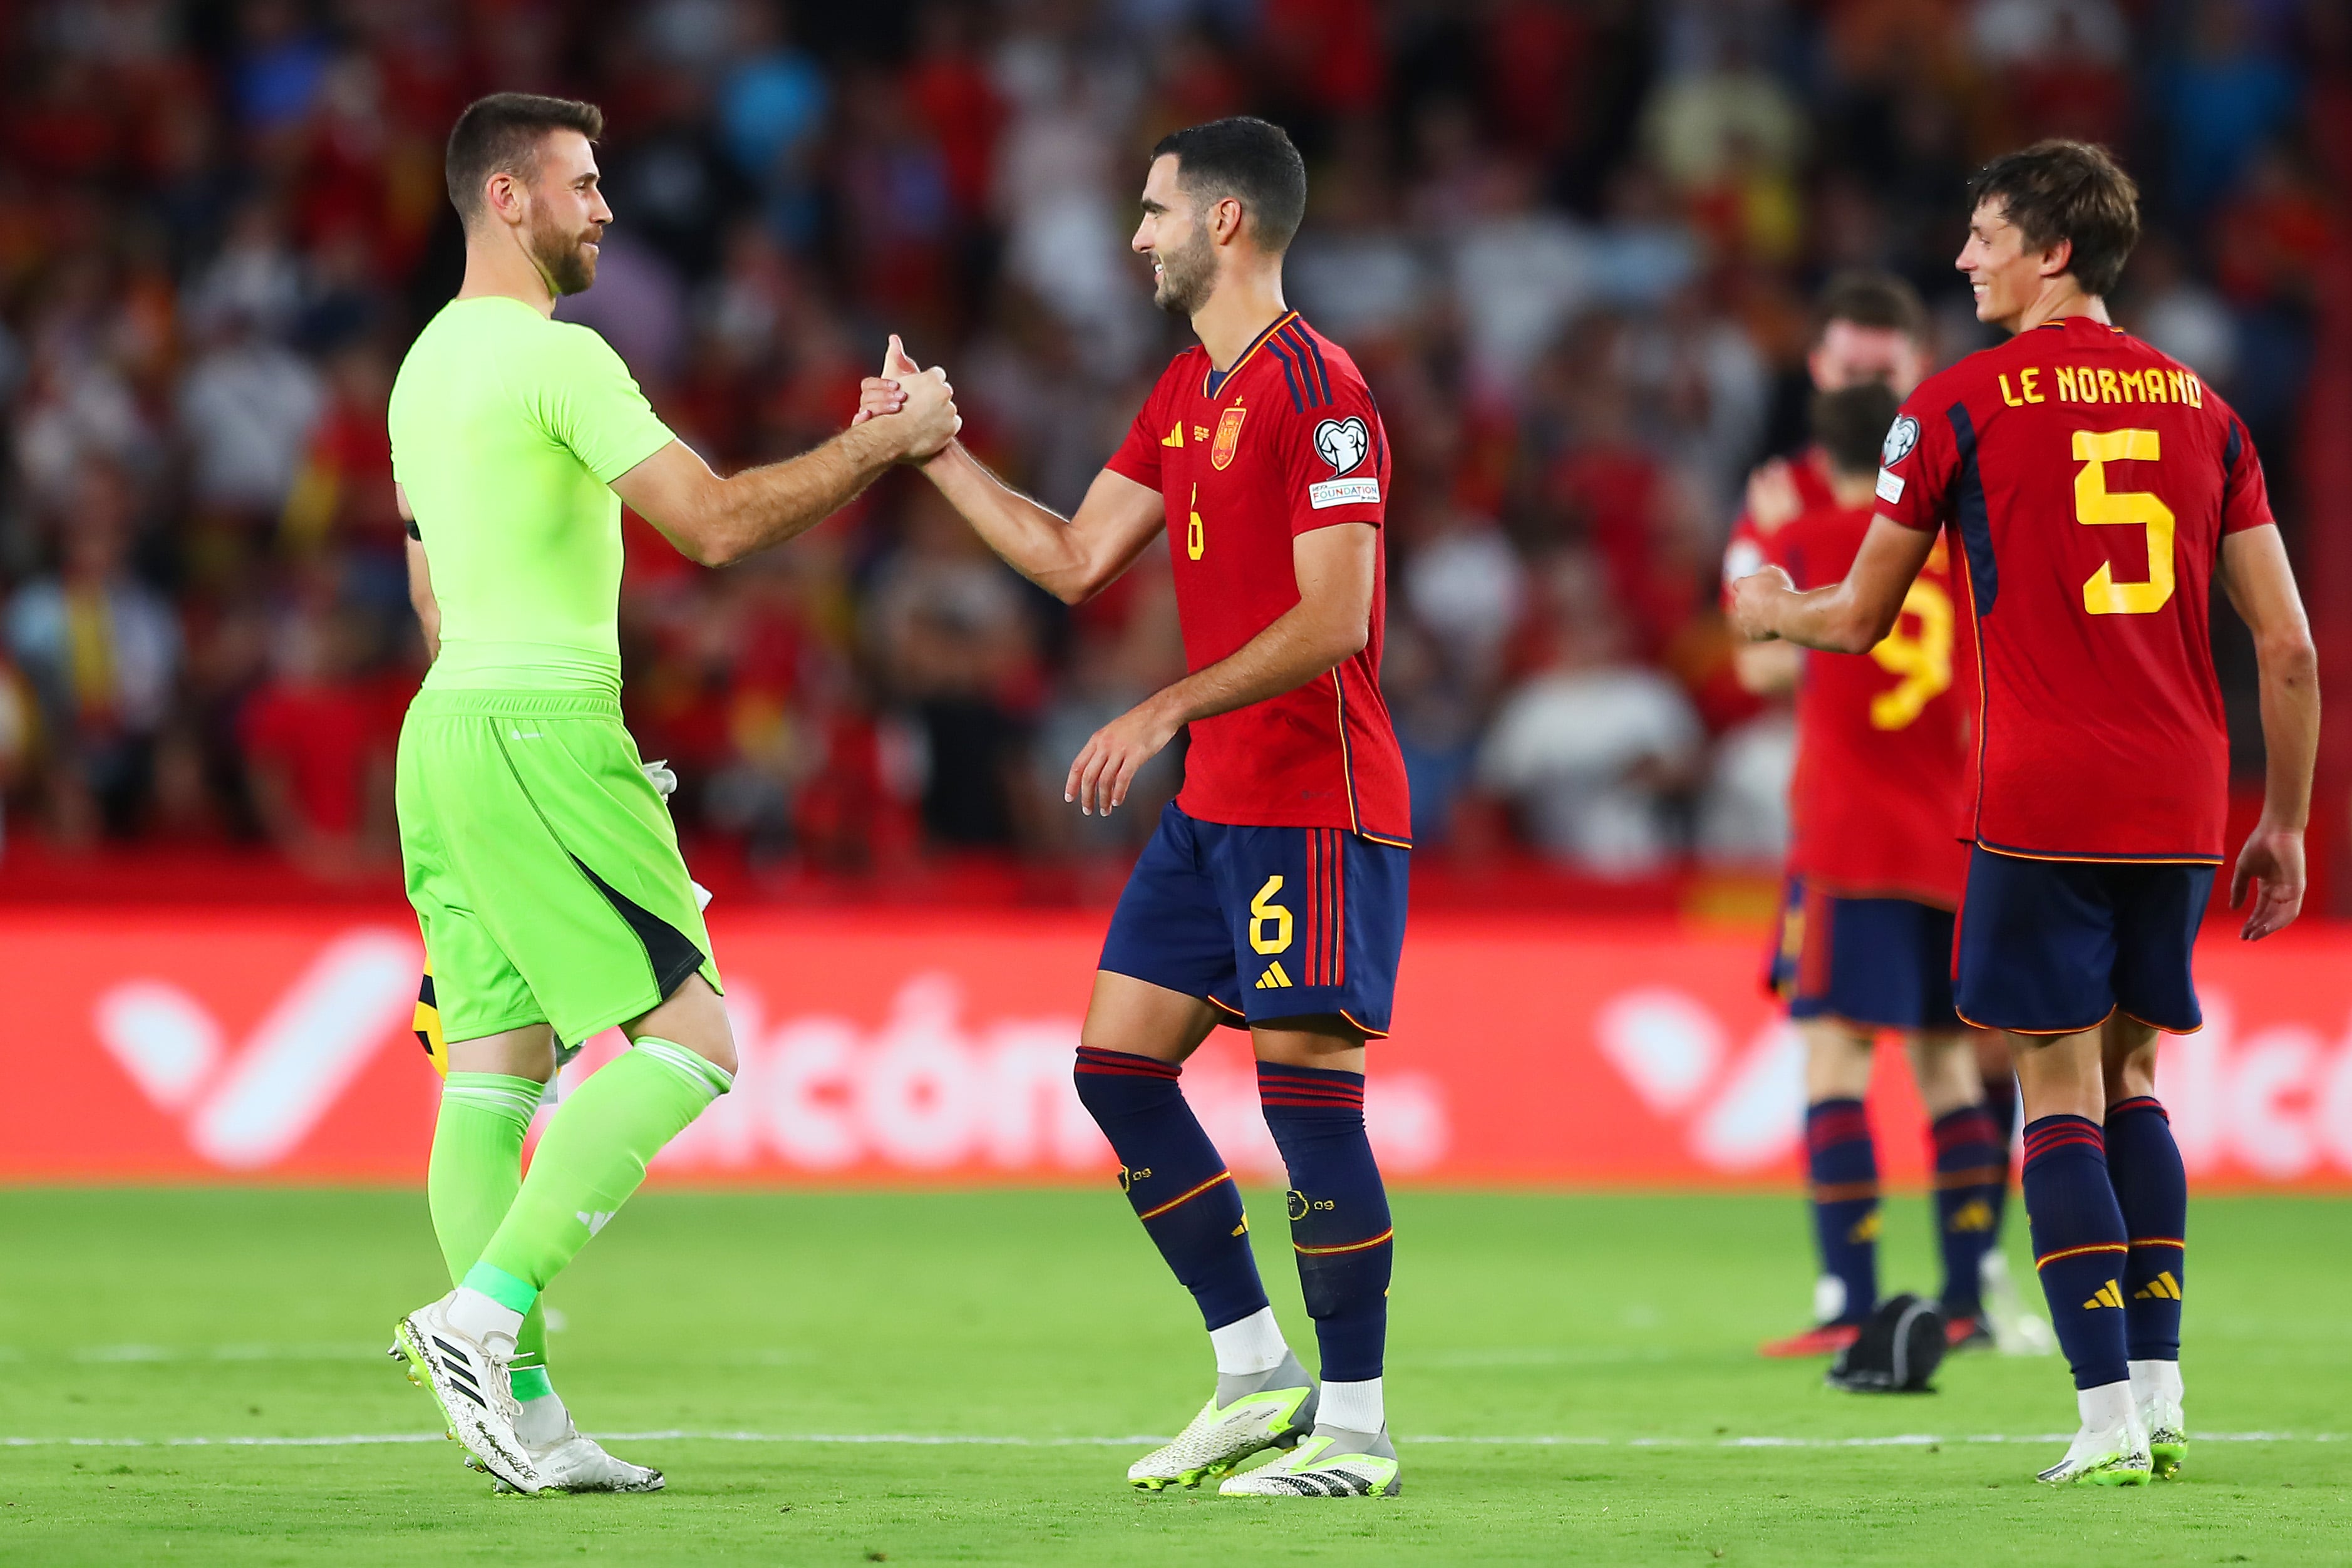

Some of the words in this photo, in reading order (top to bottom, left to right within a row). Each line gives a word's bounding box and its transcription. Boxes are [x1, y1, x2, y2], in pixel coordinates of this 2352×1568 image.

[1998, 367, 2045, 407] LE
[2054, 366, 2203, 410] NORMAND
[1313, 486, 1377, 501] FOUNDATION
[2071, 428, 2175, 615] 5
[1870, 576, 1955, 731] 9
[1249, 875, 1292, 955] 6
[1314, 1200, 1335, 1210] 09
